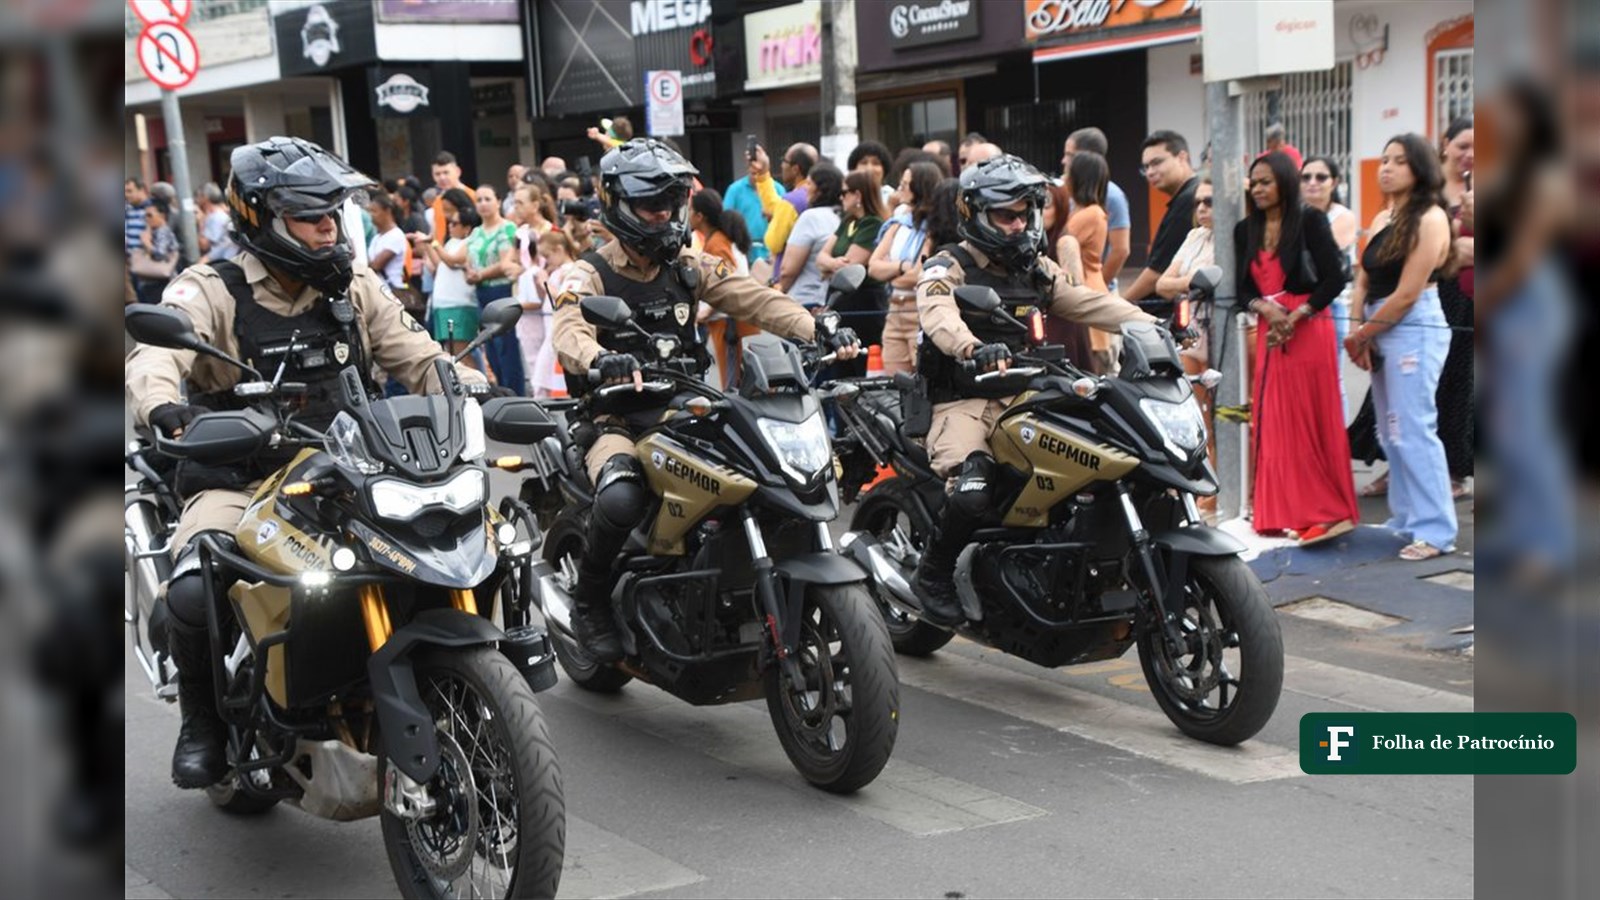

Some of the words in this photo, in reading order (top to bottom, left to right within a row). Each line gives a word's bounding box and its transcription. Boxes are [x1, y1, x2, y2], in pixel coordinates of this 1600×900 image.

[660, 79, 671, 97] E
[1038, 433, 1100, 471] GEPMOR
[665, 456, 721, 496] GEPMOR
[1036, 475, 1055, 491] 03
[667, 502, 686, 519] 02
